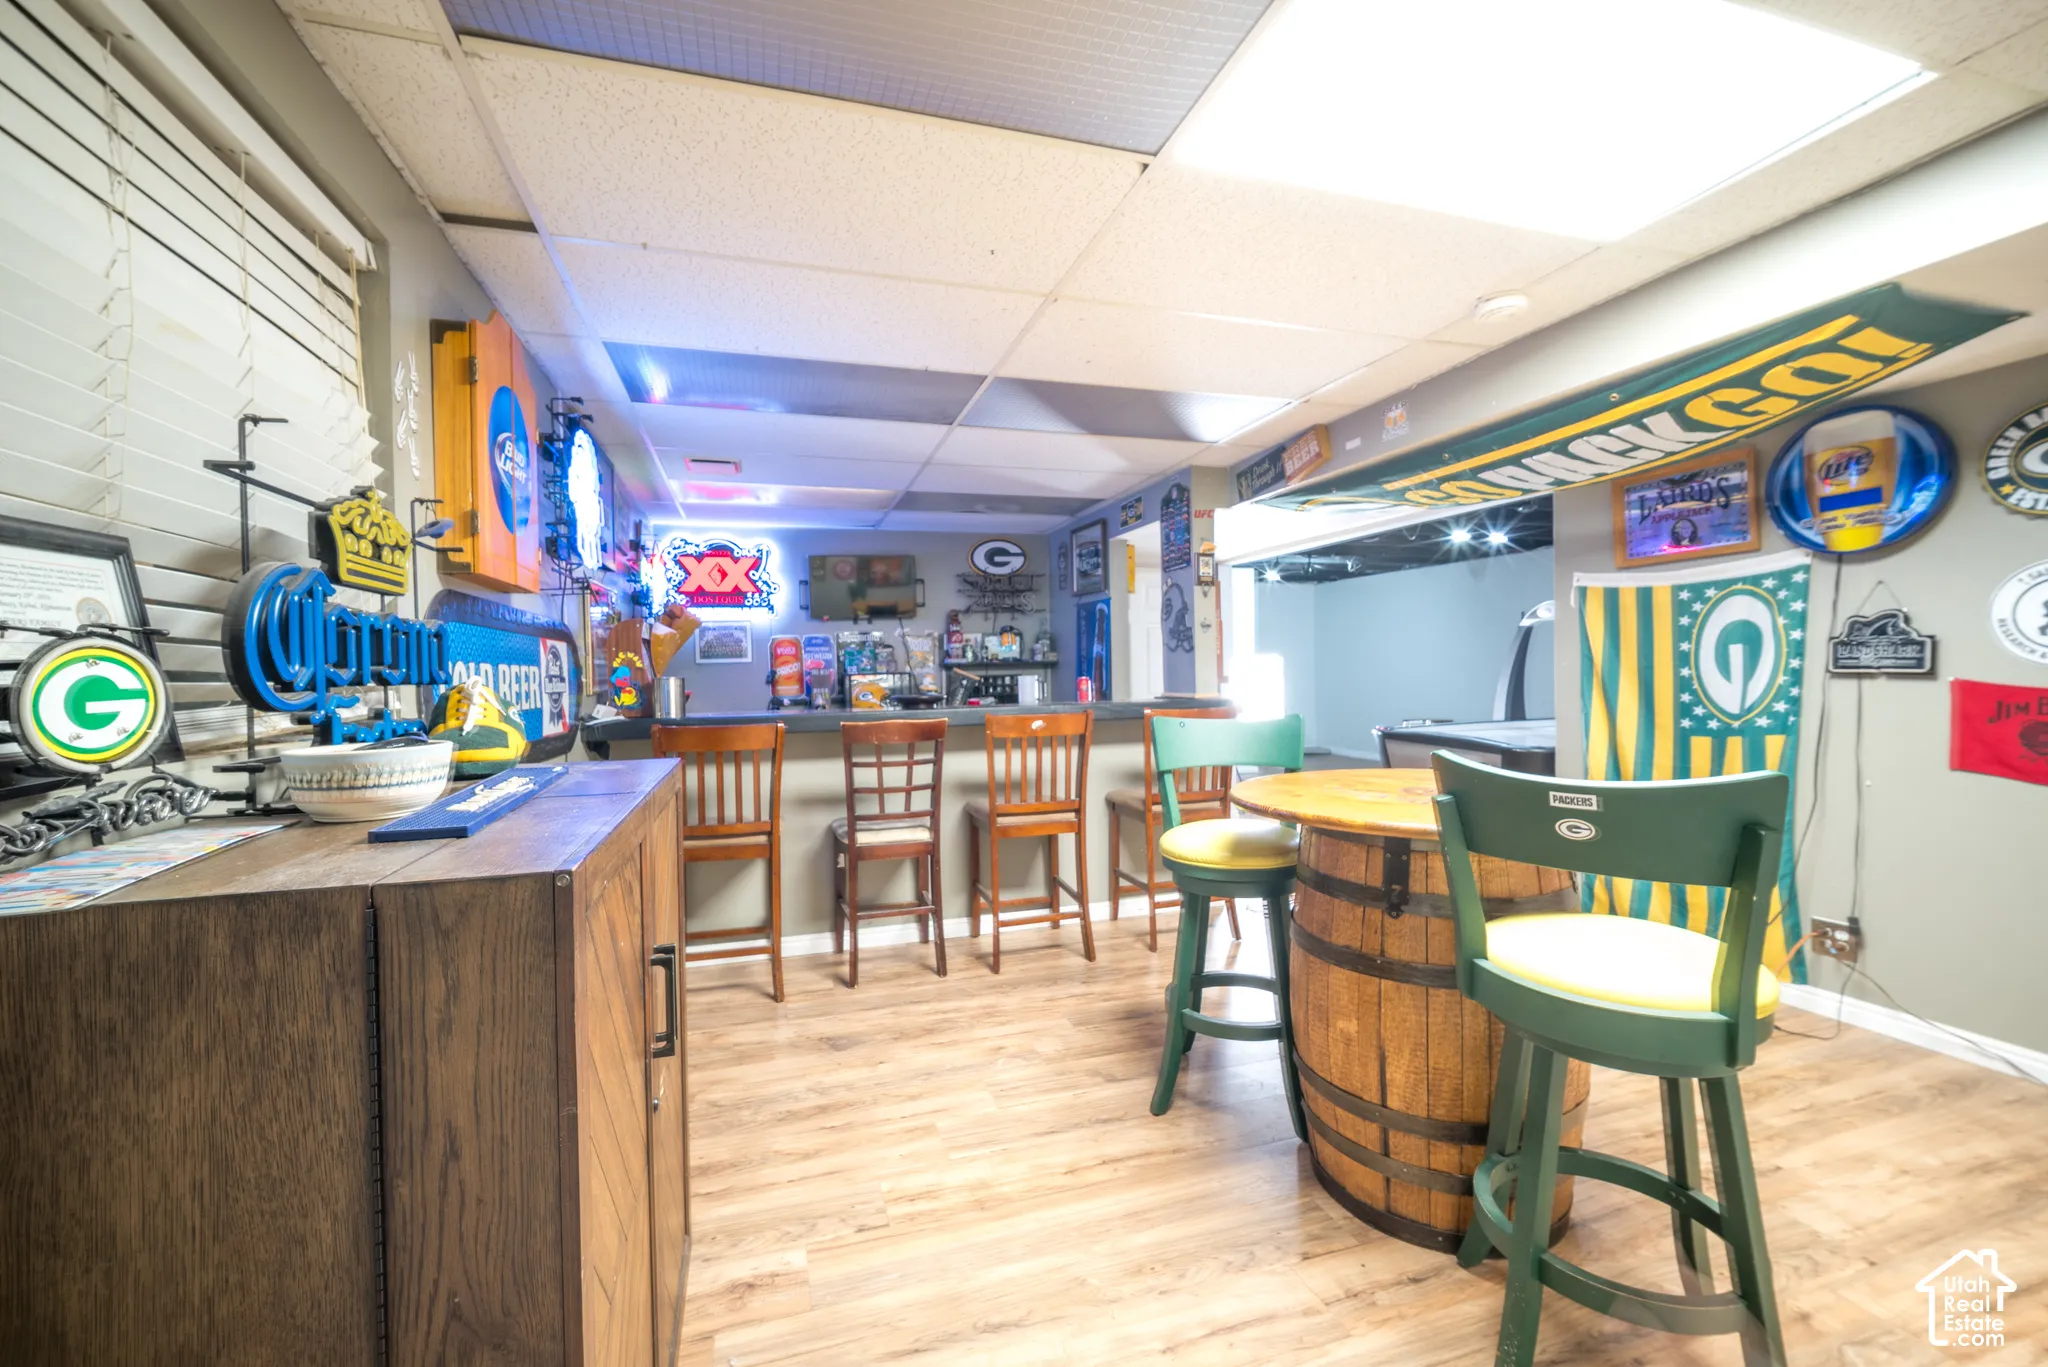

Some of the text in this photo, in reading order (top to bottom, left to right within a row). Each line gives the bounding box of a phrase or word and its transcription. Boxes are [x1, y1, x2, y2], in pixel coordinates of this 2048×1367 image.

[1478, 411, 1737, 490] PACK
[1684, 326, 1934, 428] GO!
[500, 453, 527, 485] LIGHT
[504, 440, 525, 468] BUD
[1284, 440, 1320, 474] BEER
[1987, 425, 2028, 480] GREEN
[1252, 460, 1270, 479] Drink
[1193, 509, 1214, 518] UFC
[1637, 476, 1731, 525] LAIRD'S
[677, 555, 760, 593] XX
[693, 596, 744, 604] DOS EQUIS
[245, 564, 452, 713] Corona
[498, 664, 542, 711] BEER
[1987, 699, 2031, 724] JIM
[1551, 794, 1594, 807] PACKERS
